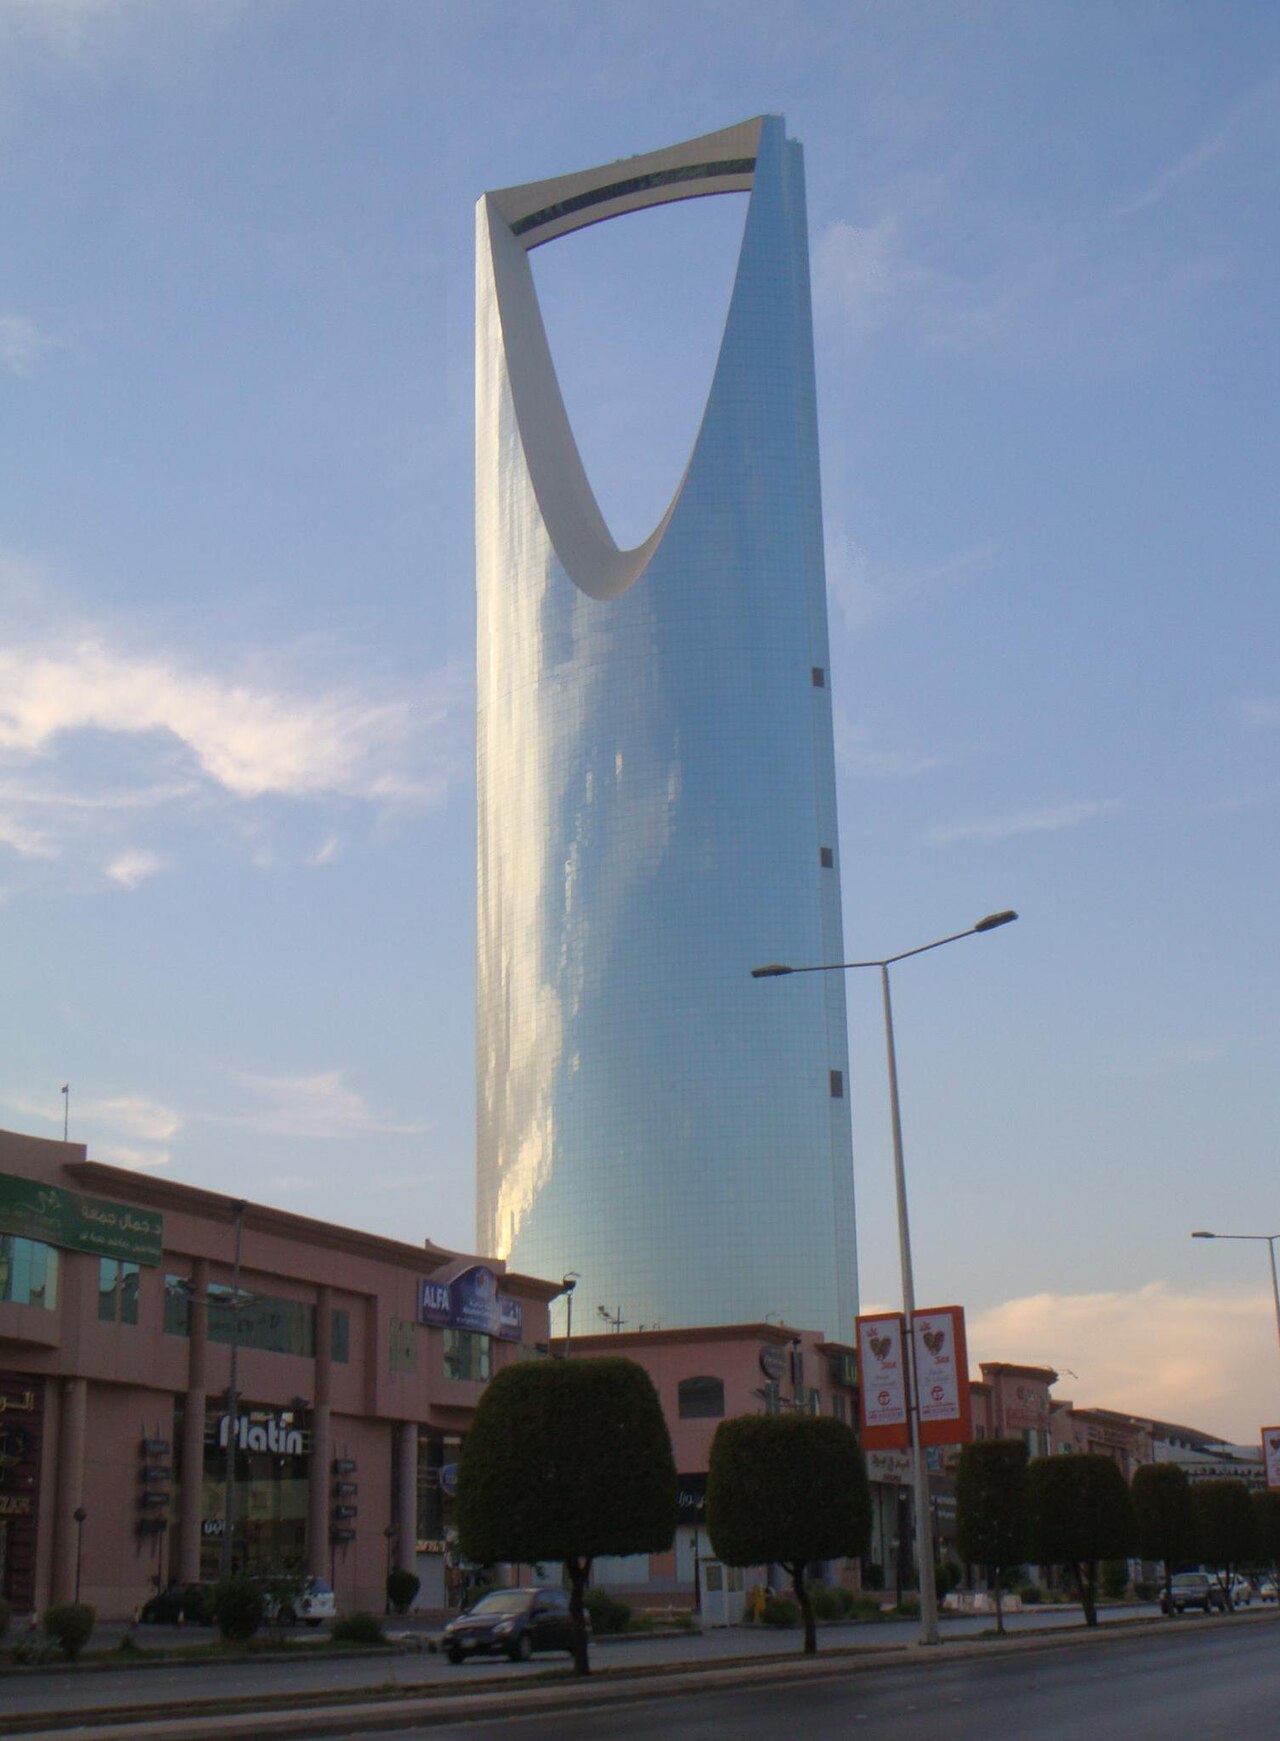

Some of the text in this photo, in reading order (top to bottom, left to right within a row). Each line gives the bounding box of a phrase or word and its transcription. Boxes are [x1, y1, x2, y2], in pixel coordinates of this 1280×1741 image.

[81, 1205, 116, 1225] جمعة
[118, 1213, 150, 1234] جمال
[423, 1285, 450, 1311] ALFA
[217, 1414, 303, 1455] Platin
